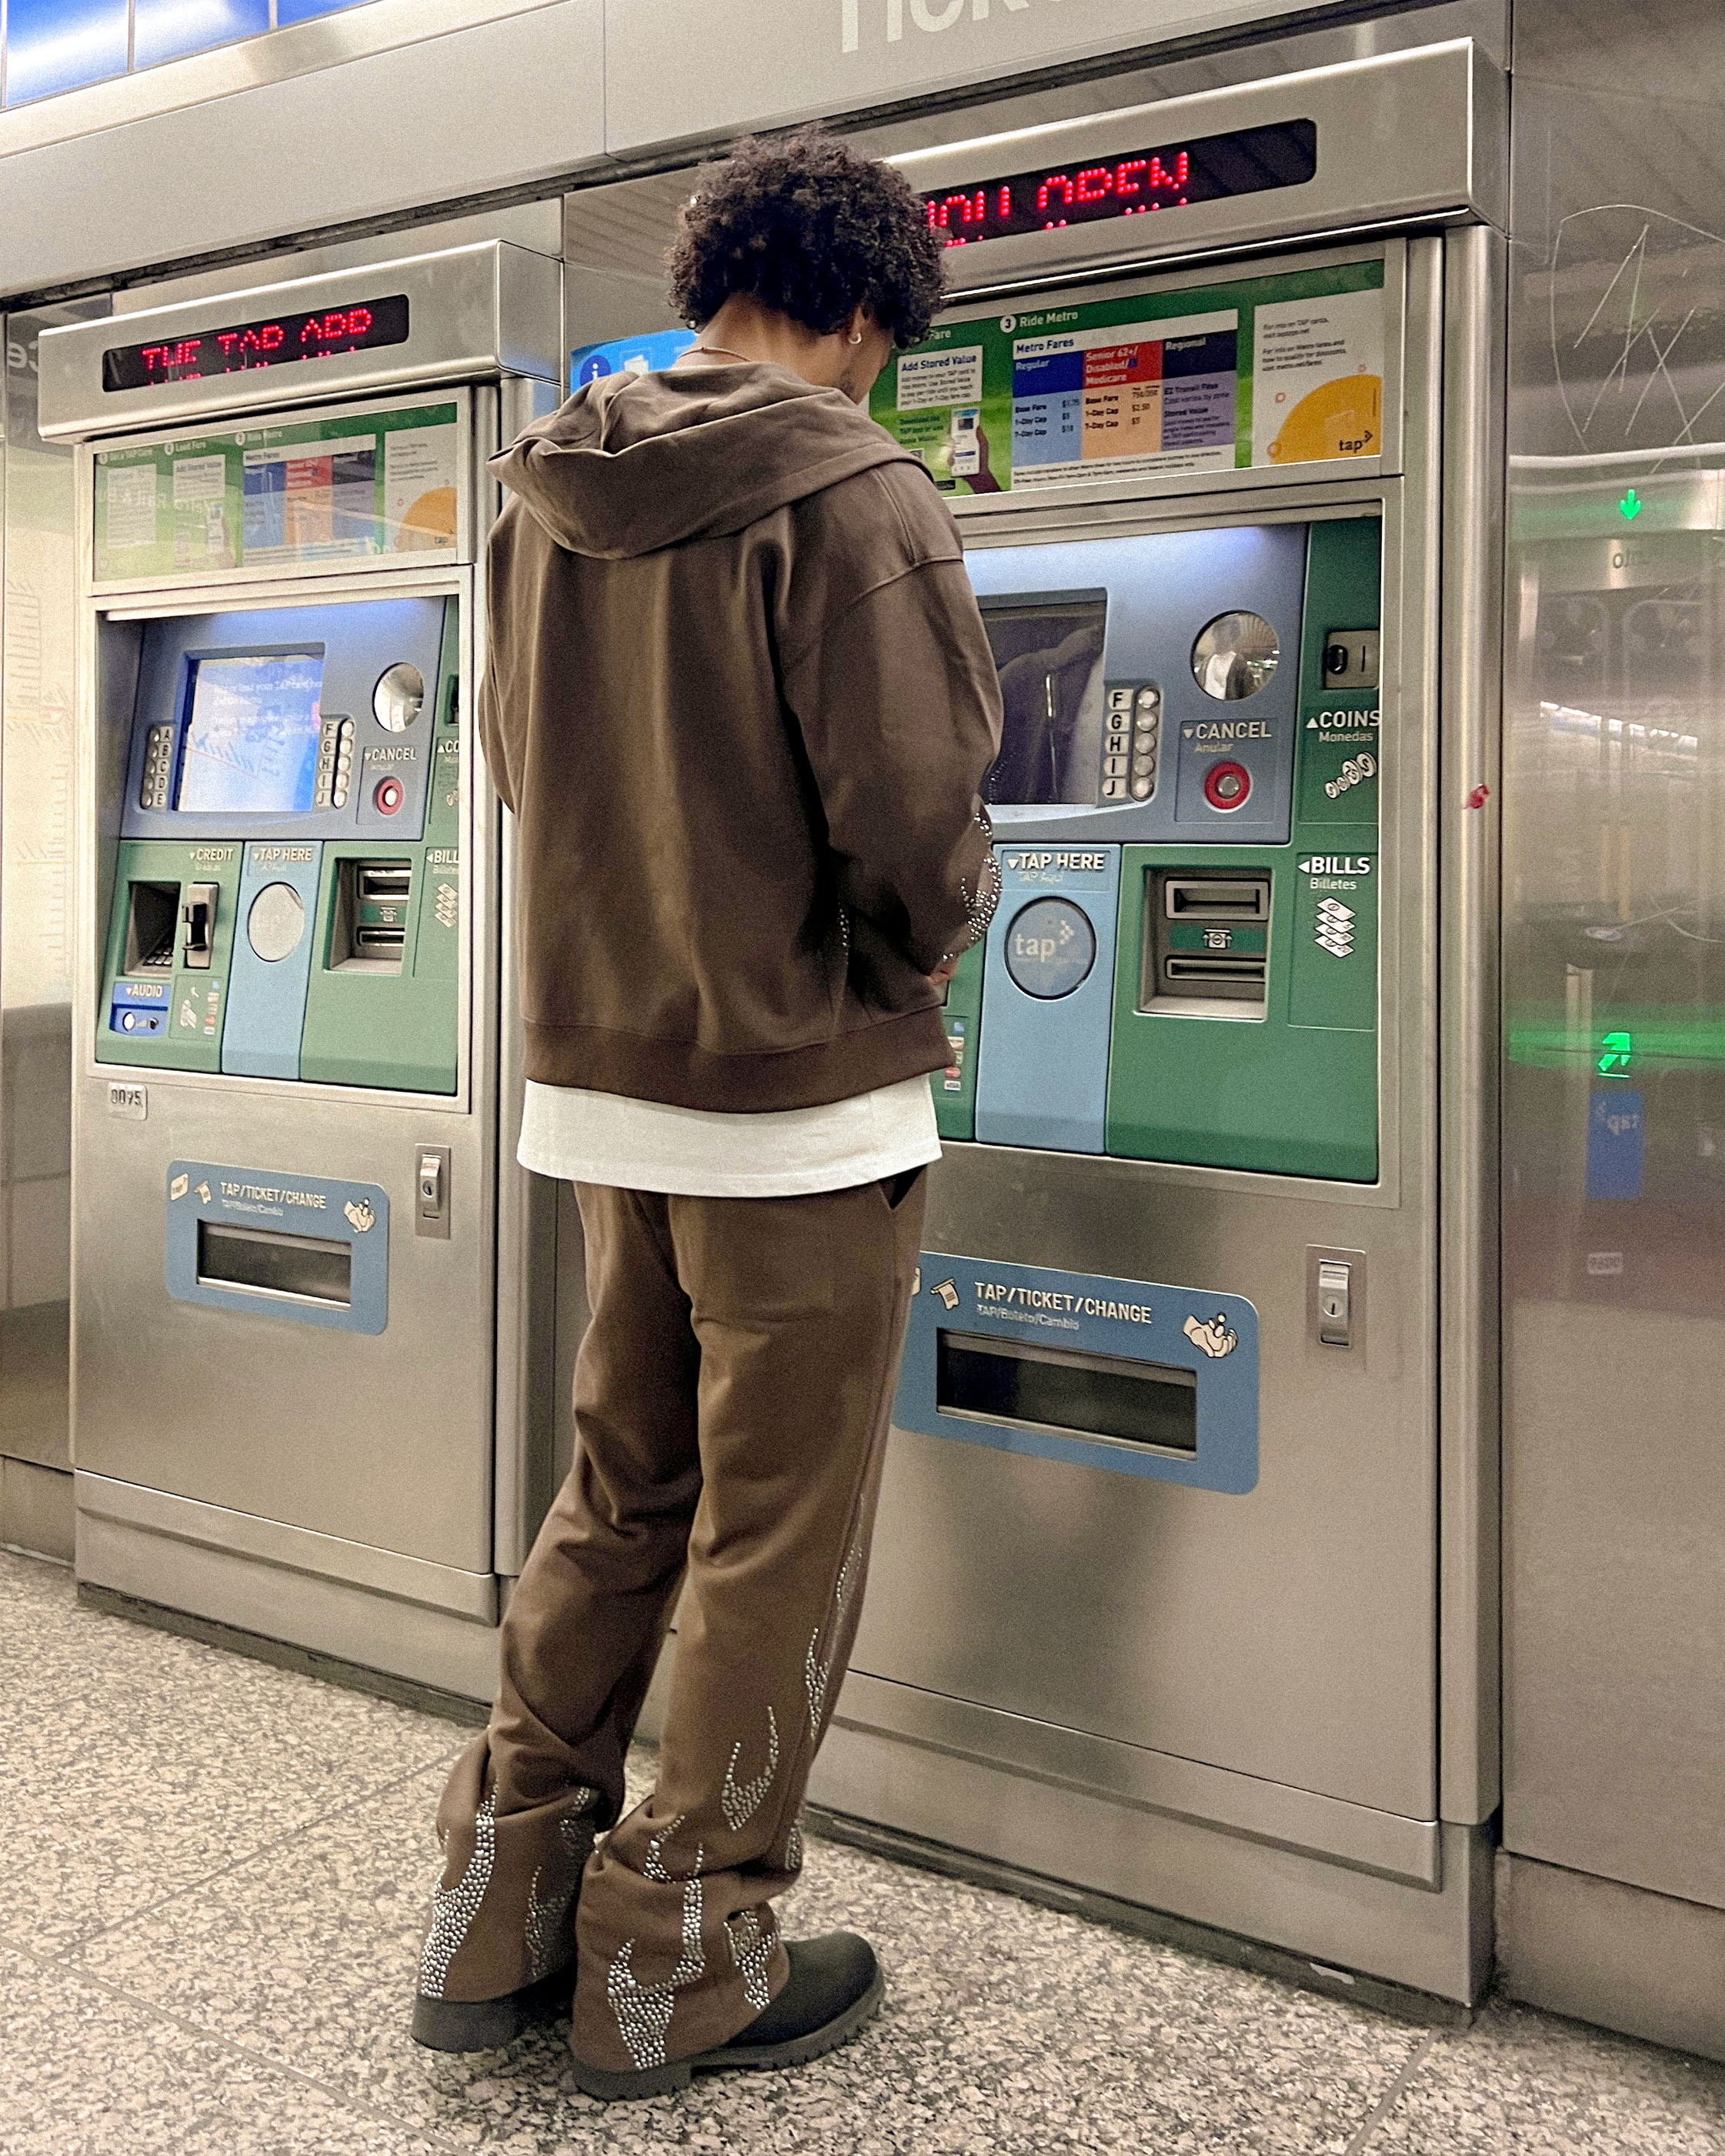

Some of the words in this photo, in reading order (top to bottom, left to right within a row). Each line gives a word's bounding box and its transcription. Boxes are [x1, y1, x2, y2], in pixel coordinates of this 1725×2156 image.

[1019, 314, 1042, 327] Ride
[1046, 311, 1078, 324] Metro
[1016, 340, 1045, 354] Metro
[1047, 338, 1074, 350] Fares
[902, 362, 918, 372] Add
[920, 357, 949, 369] Stored
[953, 355, 976, 365] Value
[1016, 359, 1049, 372] Regular
[1340, 439, 1363, 454] tap
[1113, 693, 1123, 707] F
[1111, 714, 1122, 729] G
[1320, 710, 1379, 728] COINS
[164, 729, 169, 739] A
[325, 723, 333, 735] F
[1196, 721, 1272, 739] CANCEL
[1110, 736, 1121, 752] H
[1319, 731, 1373, 743] Monedas
[162, 744, 168, 756] B
[324, 741, 331, 752] G
[1194, 742, 1233, 753] Anular
[372, 747, 417, 761] CANCEL
[161, 761, 167, 772] C
[322, 758, 329, 769] H
[159, 777, 165, 789] D
[1106, 780, 1116, 796] J
[157, 793, 163, 805] E
[319, 792, 324, 804] J
[196, 848, 234, 861] CREDIT
[259, 848, 280, 860] TAP
[283, 848, 312, 861] HERE
[435, 850, 459, 863] BILL
[1019, 853, 1052, 869] TAP
[1057, 853, 1105, 869] HERE
[1312, 856, 1370, 874] BILLS
[1310, 877, 1357, 889] Billetes
[1016, 933, 1056, 963] tap
[132, 984, 163, 998] AUDIO
[220, 1182, 327, 1209] TAP/TICKET/CHANGE
[974, 1281, 1152, 1324] TAP/TICKET/CHANGE
